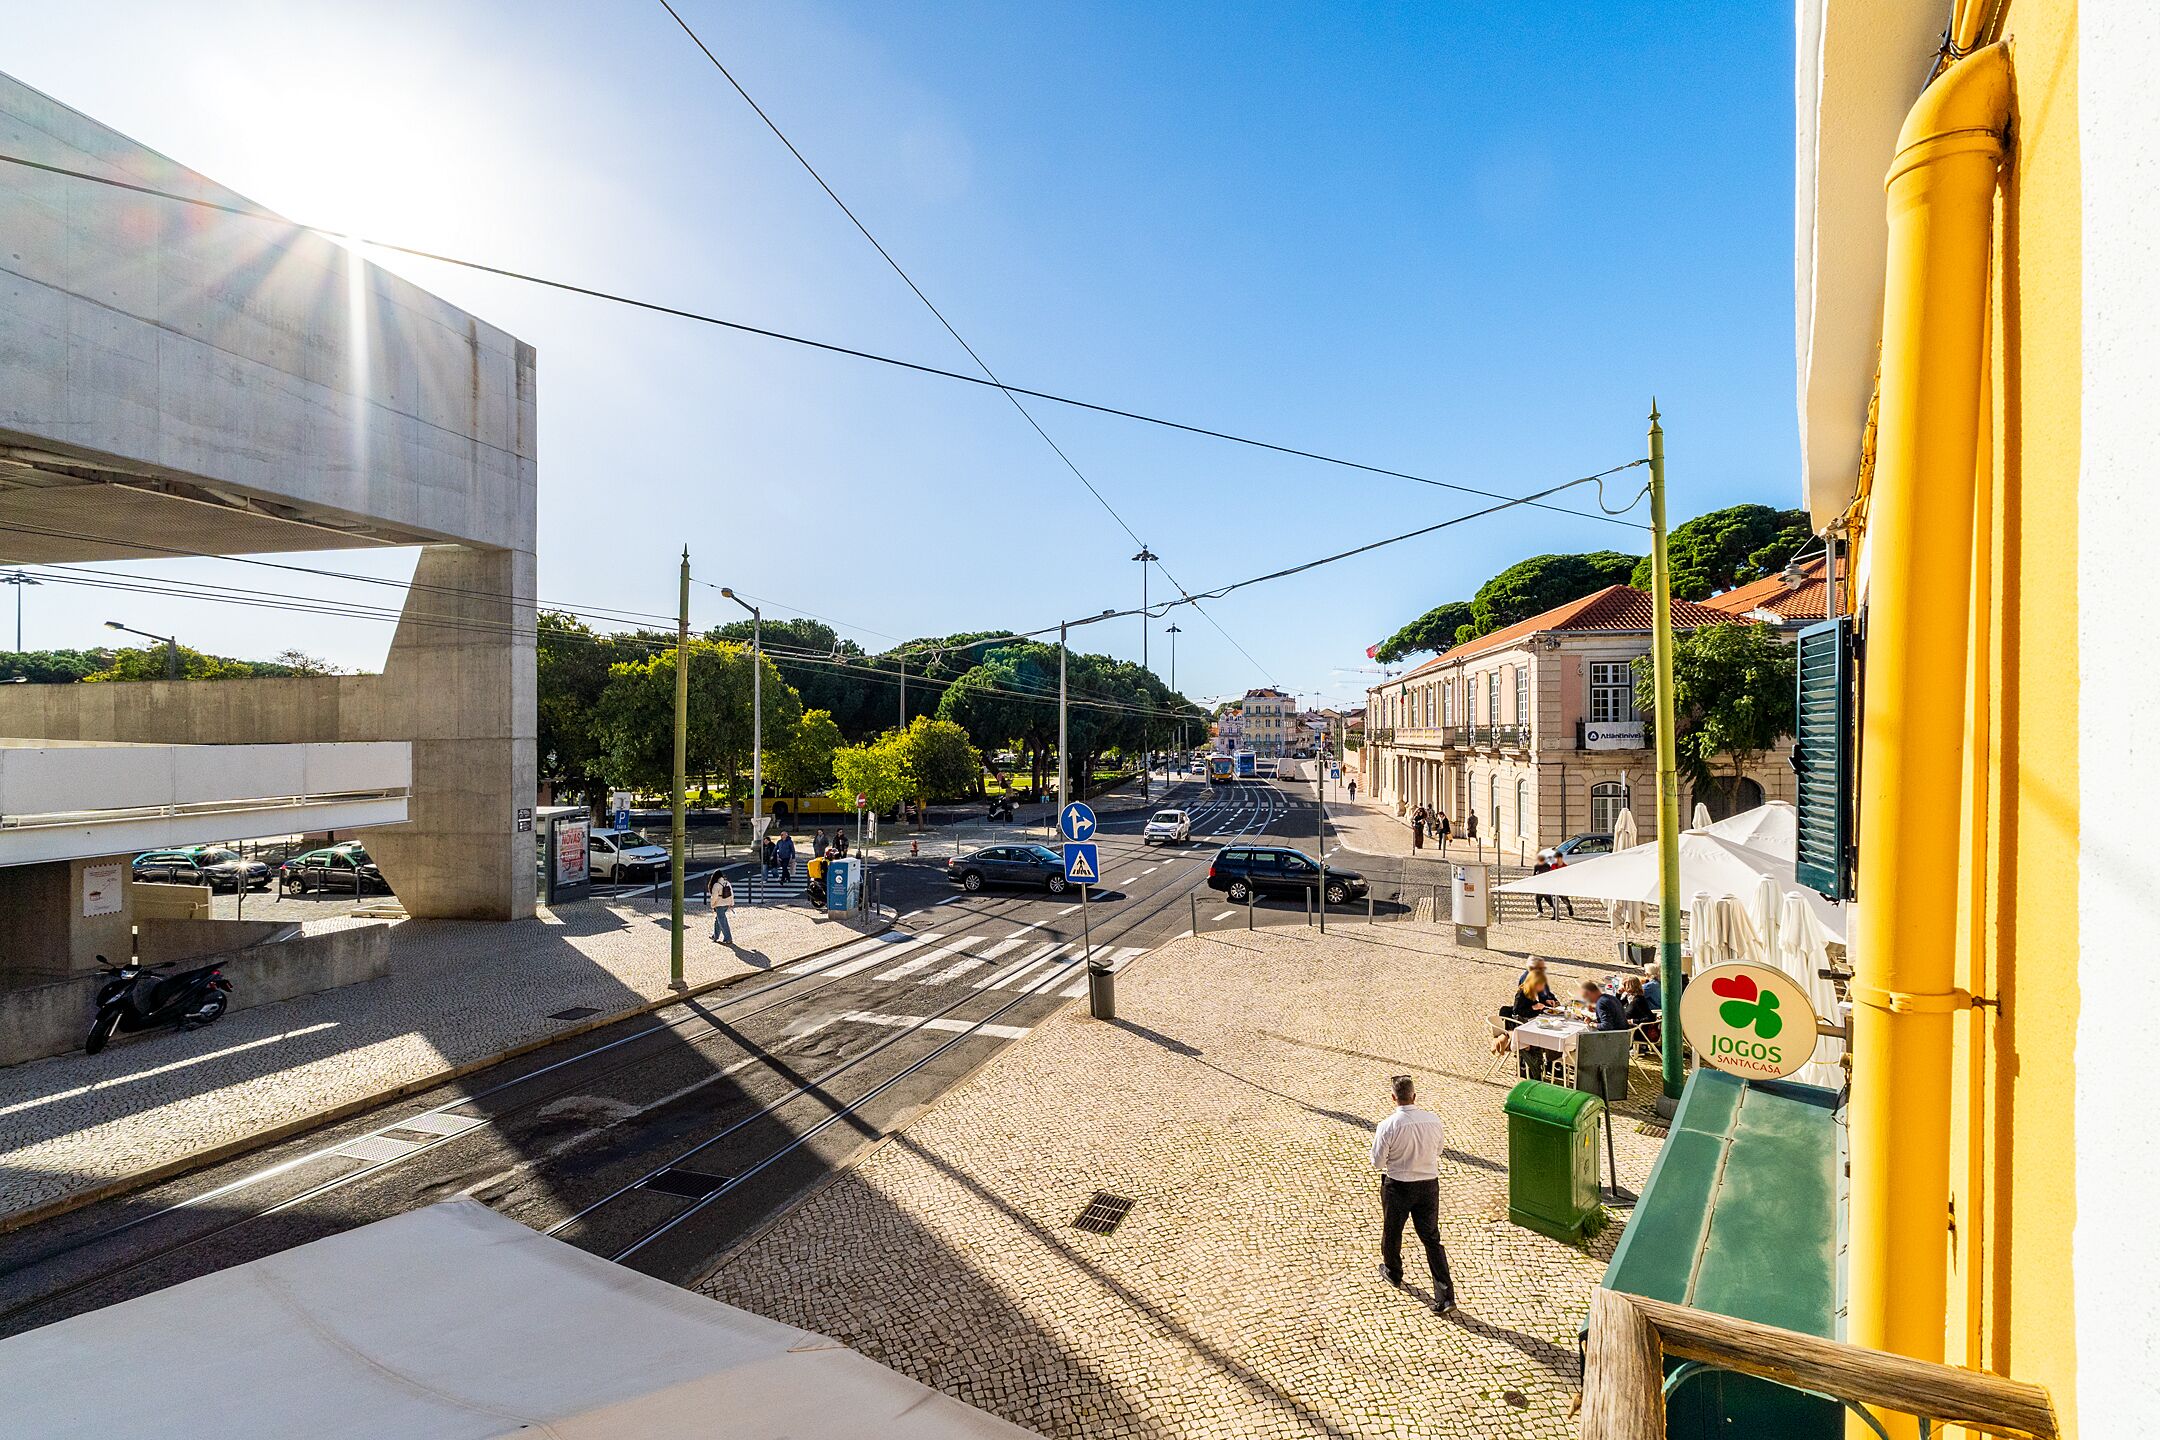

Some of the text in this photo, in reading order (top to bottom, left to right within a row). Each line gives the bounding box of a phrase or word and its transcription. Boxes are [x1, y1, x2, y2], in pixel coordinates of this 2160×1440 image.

[618, 811, 627, 824] P
[1711, 1035, 1782, 1063] JOGOS
[1717, 1054, 1782, 1075] SANTACASA
